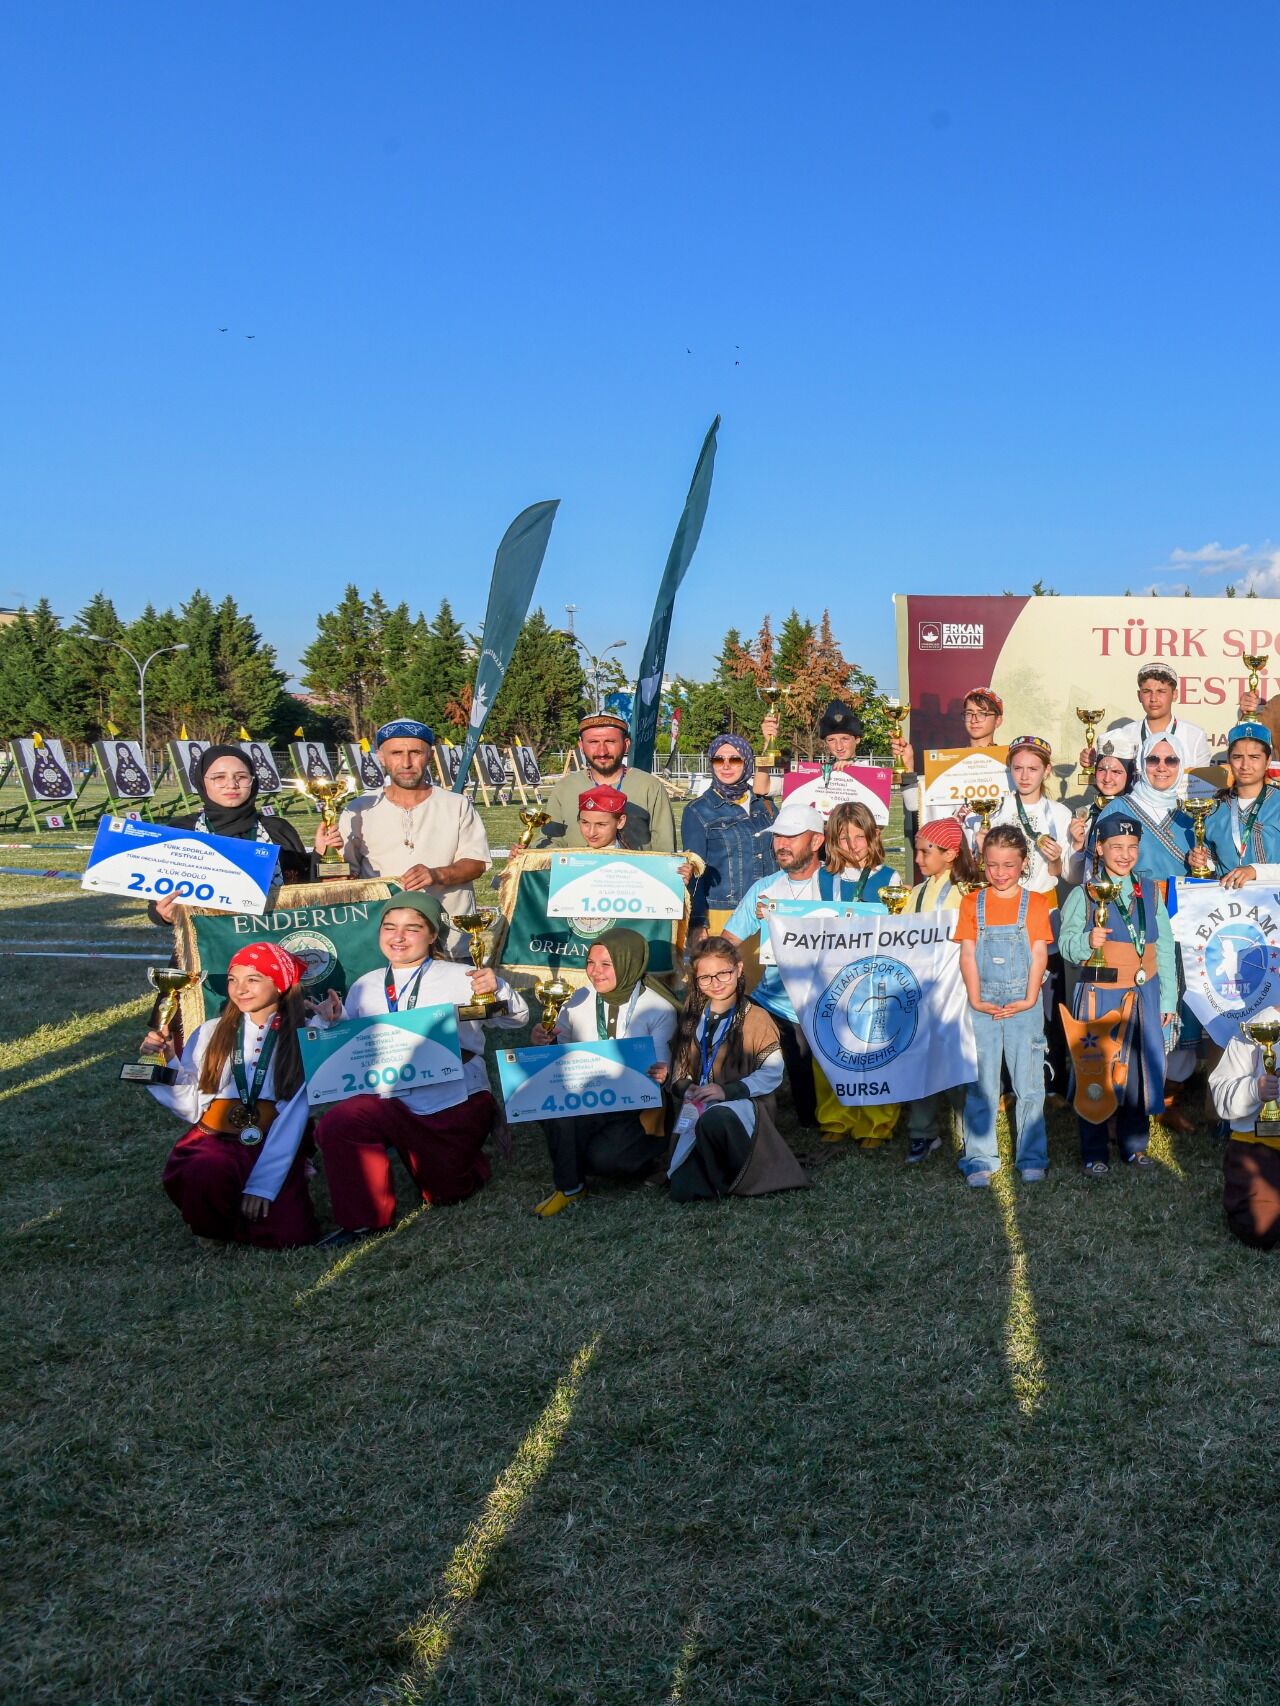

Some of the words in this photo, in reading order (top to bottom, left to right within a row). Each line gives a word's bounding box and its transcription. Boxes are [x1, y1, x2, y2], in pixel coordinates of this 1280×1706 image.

[943, 623, 984, 634] ERKAN
[1092, 618, 1207, 657] TÜRK
[945, 634, 982, 645] AYDIN
[950, 783, 1000, 800] 2.000
[51, 816, 60, 827] 8
[127, 873, 215, 901] 2.000
[219, 895, 232, 905] TL
[581, 897, 642, 913] 1.000
[232, 903, 369, 934] ENDERUN
[1195, 902, 1278, 941] ENDAM
[783, 931, 873, 950] PAYİTAHT
[862, 962, 895, 975] SPOR
[342, 1063, 416, 1092] 2.000
[420, 1069, 434, 1079] TL
[836, 1081, 891, 1097] BURSA
[541, 1089, 617, 1112] 4.000
[621, 1095, 635, 1104] TL
